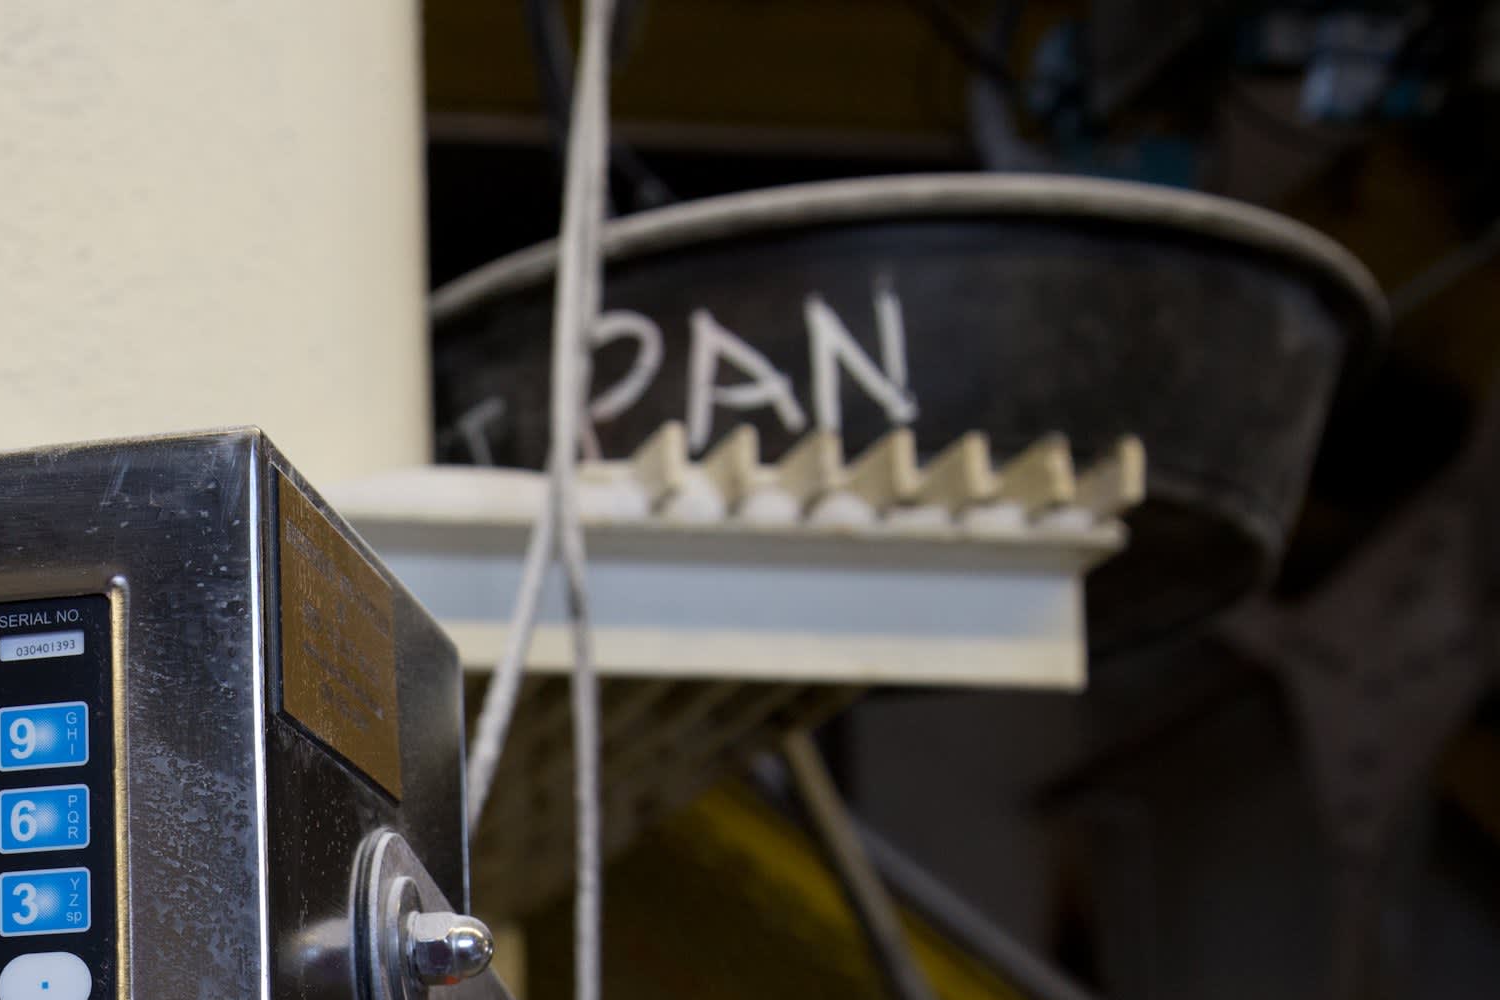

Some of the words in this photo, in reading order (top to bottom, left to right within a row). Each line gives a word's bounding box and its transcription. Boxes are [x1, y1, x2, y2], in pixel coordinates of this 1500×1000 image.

[56, 609, 83, 623] NO.
[16, 640, 76, 657] 030401393
[9, 717, 36, 760] 9
[10, 800, 38, 842] 6
[12, 882, 38, 925] 3
